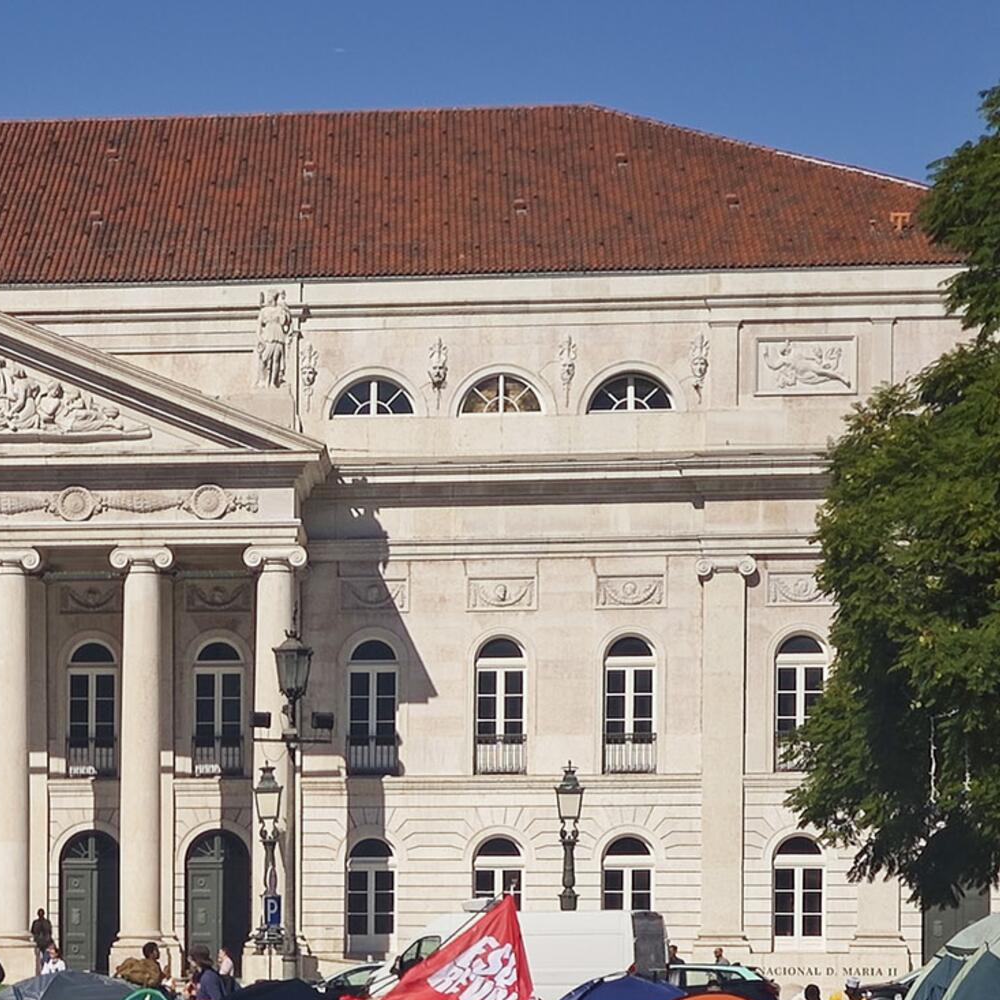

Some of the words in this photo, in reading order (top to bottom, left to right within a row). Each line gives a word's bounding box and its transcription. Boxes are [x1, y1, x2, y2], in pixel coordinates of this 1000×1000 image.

[266, 898, 279, 923] P
[826, 966, 838, 977] D.
[842, 967, 884, 977] MARIA
[888, 967, 899, 977] II
